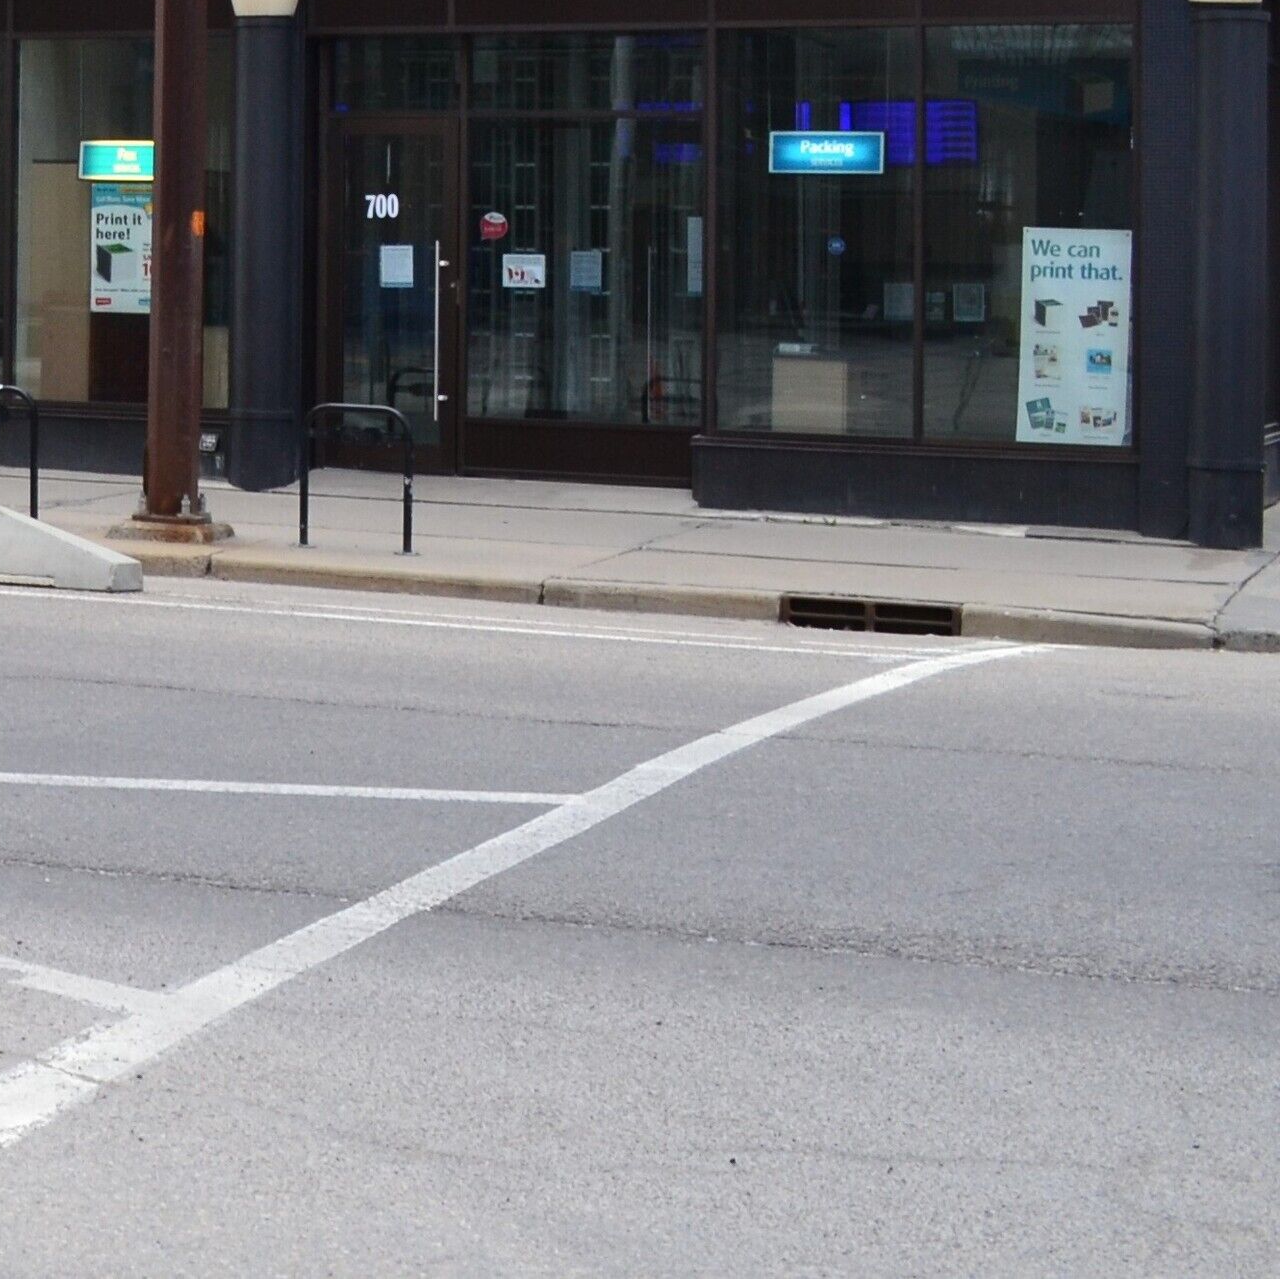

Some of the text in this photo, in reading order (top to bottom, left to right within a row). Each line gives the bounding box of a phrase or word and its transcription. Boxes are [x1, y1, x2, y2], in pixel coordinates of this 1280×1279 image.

[799, 140, 855, 158] Packing
[365, 194, 400, 219] 700
[96, 213, 143, 226] Print it
[96, 228, 131, 241] here!
[1031, 239, 1101, 259] We can
[1030, 261, 1124, 282] print that.
